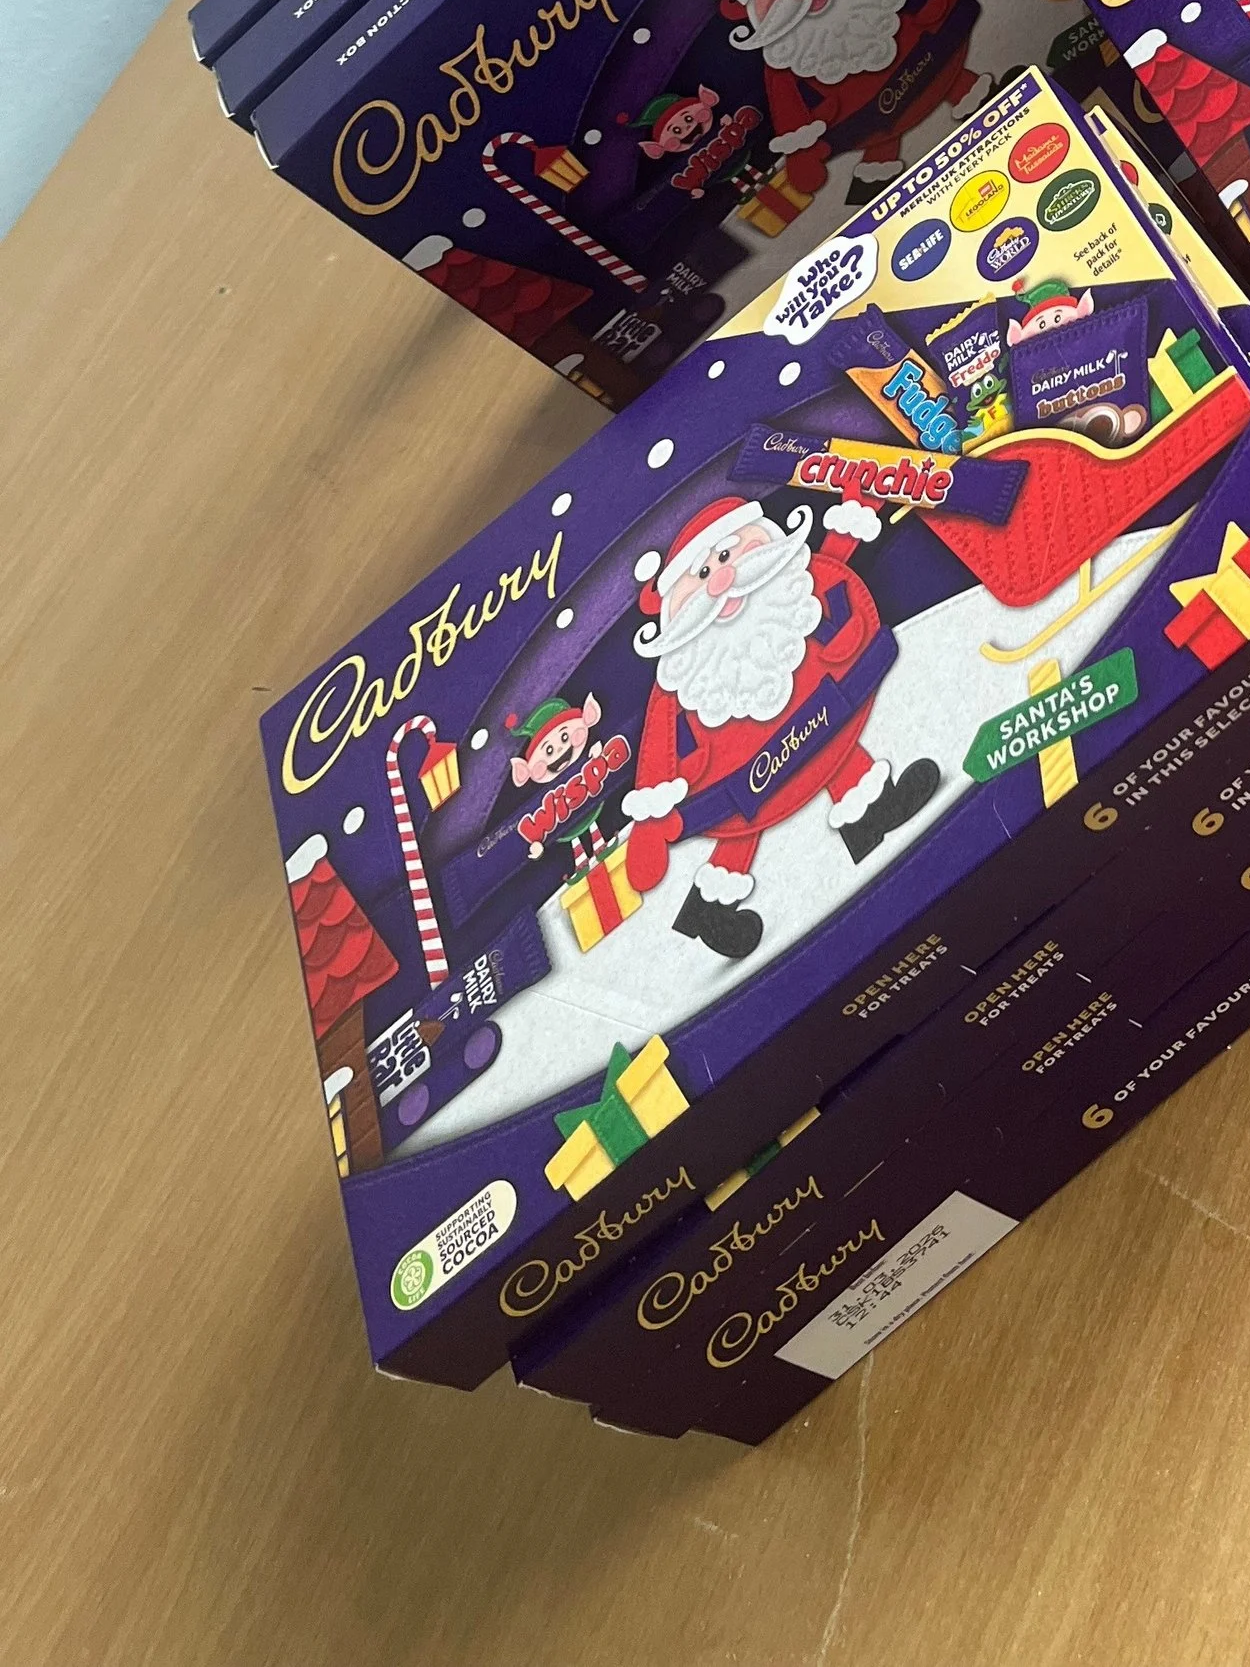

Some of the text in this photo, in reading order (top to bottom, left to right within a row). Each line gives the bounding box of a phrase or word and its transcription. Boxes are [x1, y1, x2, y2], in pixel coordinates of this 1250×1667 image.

[336, 37, 366, 65] BOX
[872, 192, 901, 220] UP
[902, 167, 933, 193] TO
[935, 128, 981, 169] 50%
[900, 107, 1029, 217] MERLIN UK ATTRACTIONS
[927, 133, 1012, 204] WITH EVERY PACK
[798, 250, 840, 287] Who
[990, 237, 1031, 273] WORLD
[1074, 223, 1117, 261] See back of
[1087, 239, 1117, 268] pack for
[776, 266, 839, 323] will you
[789, 245, 863, 328] Take?
[945, 333, 978, 365] DAIRY
[946, 344, 979, 373] MILK
[949, 345, 1004, 388] Freddo
[1032, 358, 1109, 395] DAIRY MILK
[1036, 372, 1125, 414] buttons
[801, 455, 954, 501] crunchie
[283, 531, 562, 794] Cadbury
[987, 684, 1118, 769] WORKSHOP
[1000, 675, 1093, 739] SANTA'S
[750, 707, 828, 793] Cadbury
[1126, 787, 1148, 805] IN
[1148, 749, 1193, 784] THIS
[517, 735, 631, 848] Wispa
[1084, 802, 1118, 830] 6
[1113, 772, 1137, 795] OF
[1140, 729, 1194, 770] YOUR
[1193, 808, 1224, 835] 6
[1220, 777, 1242, 800] OF
[463, 970, 482, 1014] MILK
[475, 955, 496, 1004] DAIRY
[843, 934, 941, 1015] OPEN HERE
[859, 945, 947, 1018] FOR TREATS
[965, 941, 1058, 1022] OPEN HERE
[979, 952, 1063, 1026] FOR TREATS
[1082, 1104, 1113, 1128] 6
[1114, 1081, 1135, 1101] OF
[1137, 1041, 1186, 1078] YOUR
[436, 1192, 490, 1241] SUPPORTING
[438, 1203, 491, 1250] SUSTAINABLY
[440, 1210, 495, 1261] SOURCED
[500, 1167, 696, 1316] Cadbury
[443, 1223, 498, 1274] COCOA
[638, 1176, 824, 1329] Cadbury
[707, 1219, 885, 1368] Cadbury
